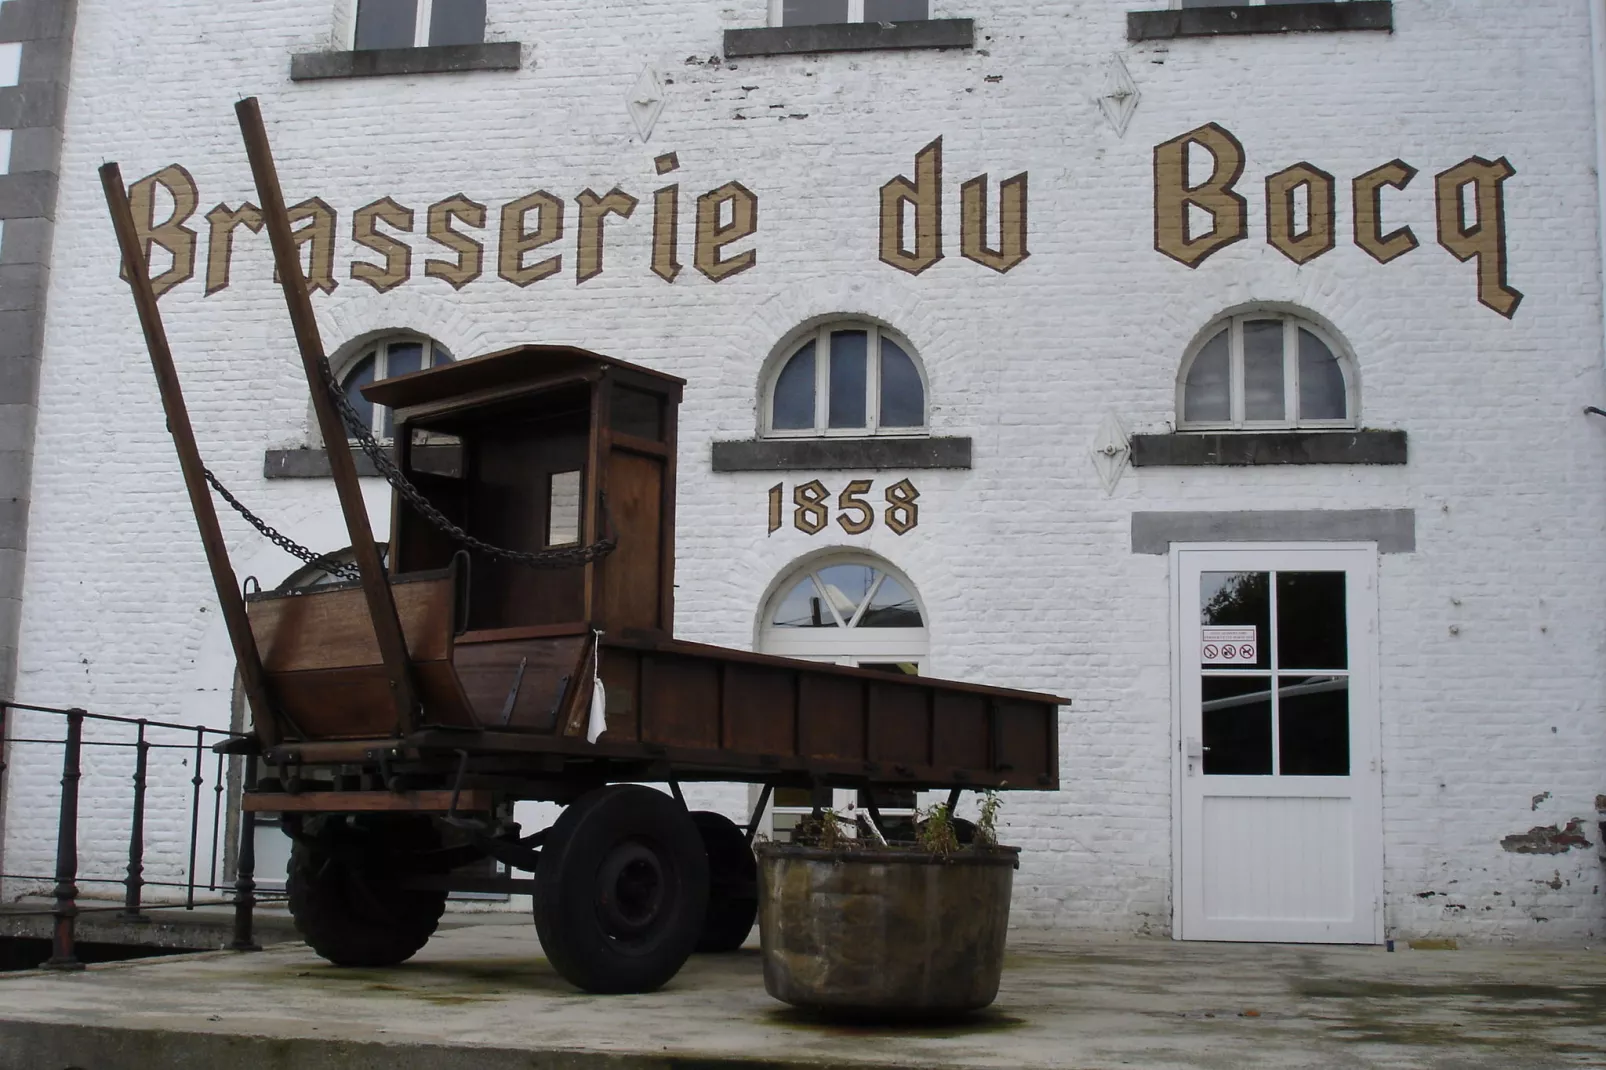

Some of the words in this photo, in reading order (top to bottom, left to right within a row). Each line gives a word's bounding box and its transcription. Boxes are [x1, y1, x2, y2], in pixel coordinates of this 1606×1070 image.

[119, 152, 758, 299] Brasserie
[879, 134, 1031, 276] du
[1153, 121, 1524, 319] Bocq
[768, 478, 921, 537] 1858
